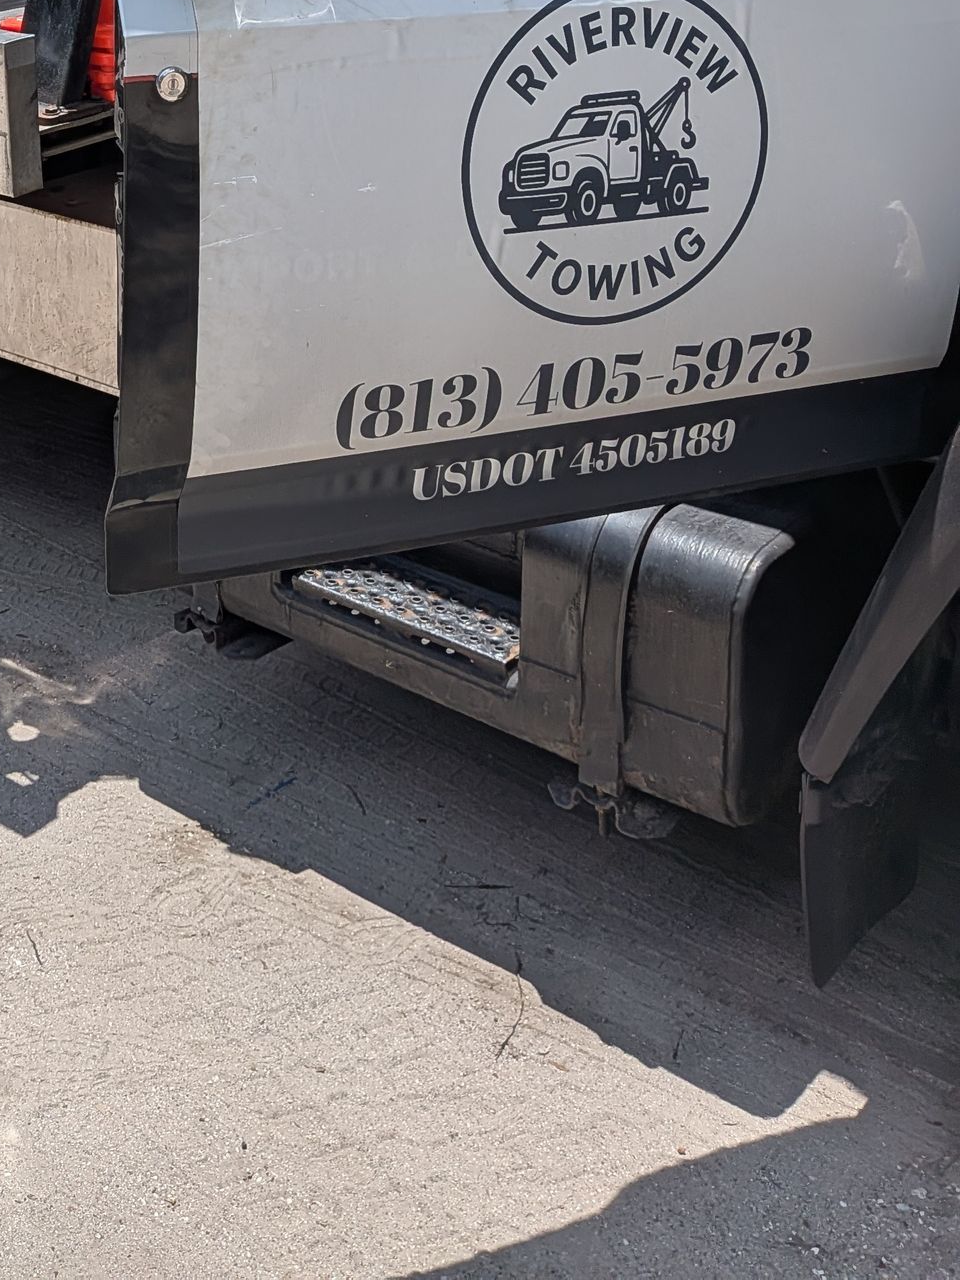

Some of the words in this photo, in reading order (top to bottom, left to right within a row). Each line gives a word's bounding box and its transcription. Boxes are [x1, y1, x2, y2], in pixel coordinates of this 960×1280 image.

[505, 6, 740, 106] RIVERVIEW
[525, 225, 707, 302] TOWING
[335, 366, 503, 450] (813)
[516, 327, 813, 417] 405-5973
[411, 445, 563, 501] USDOT
[570, 418, 736, 477] 4505189
